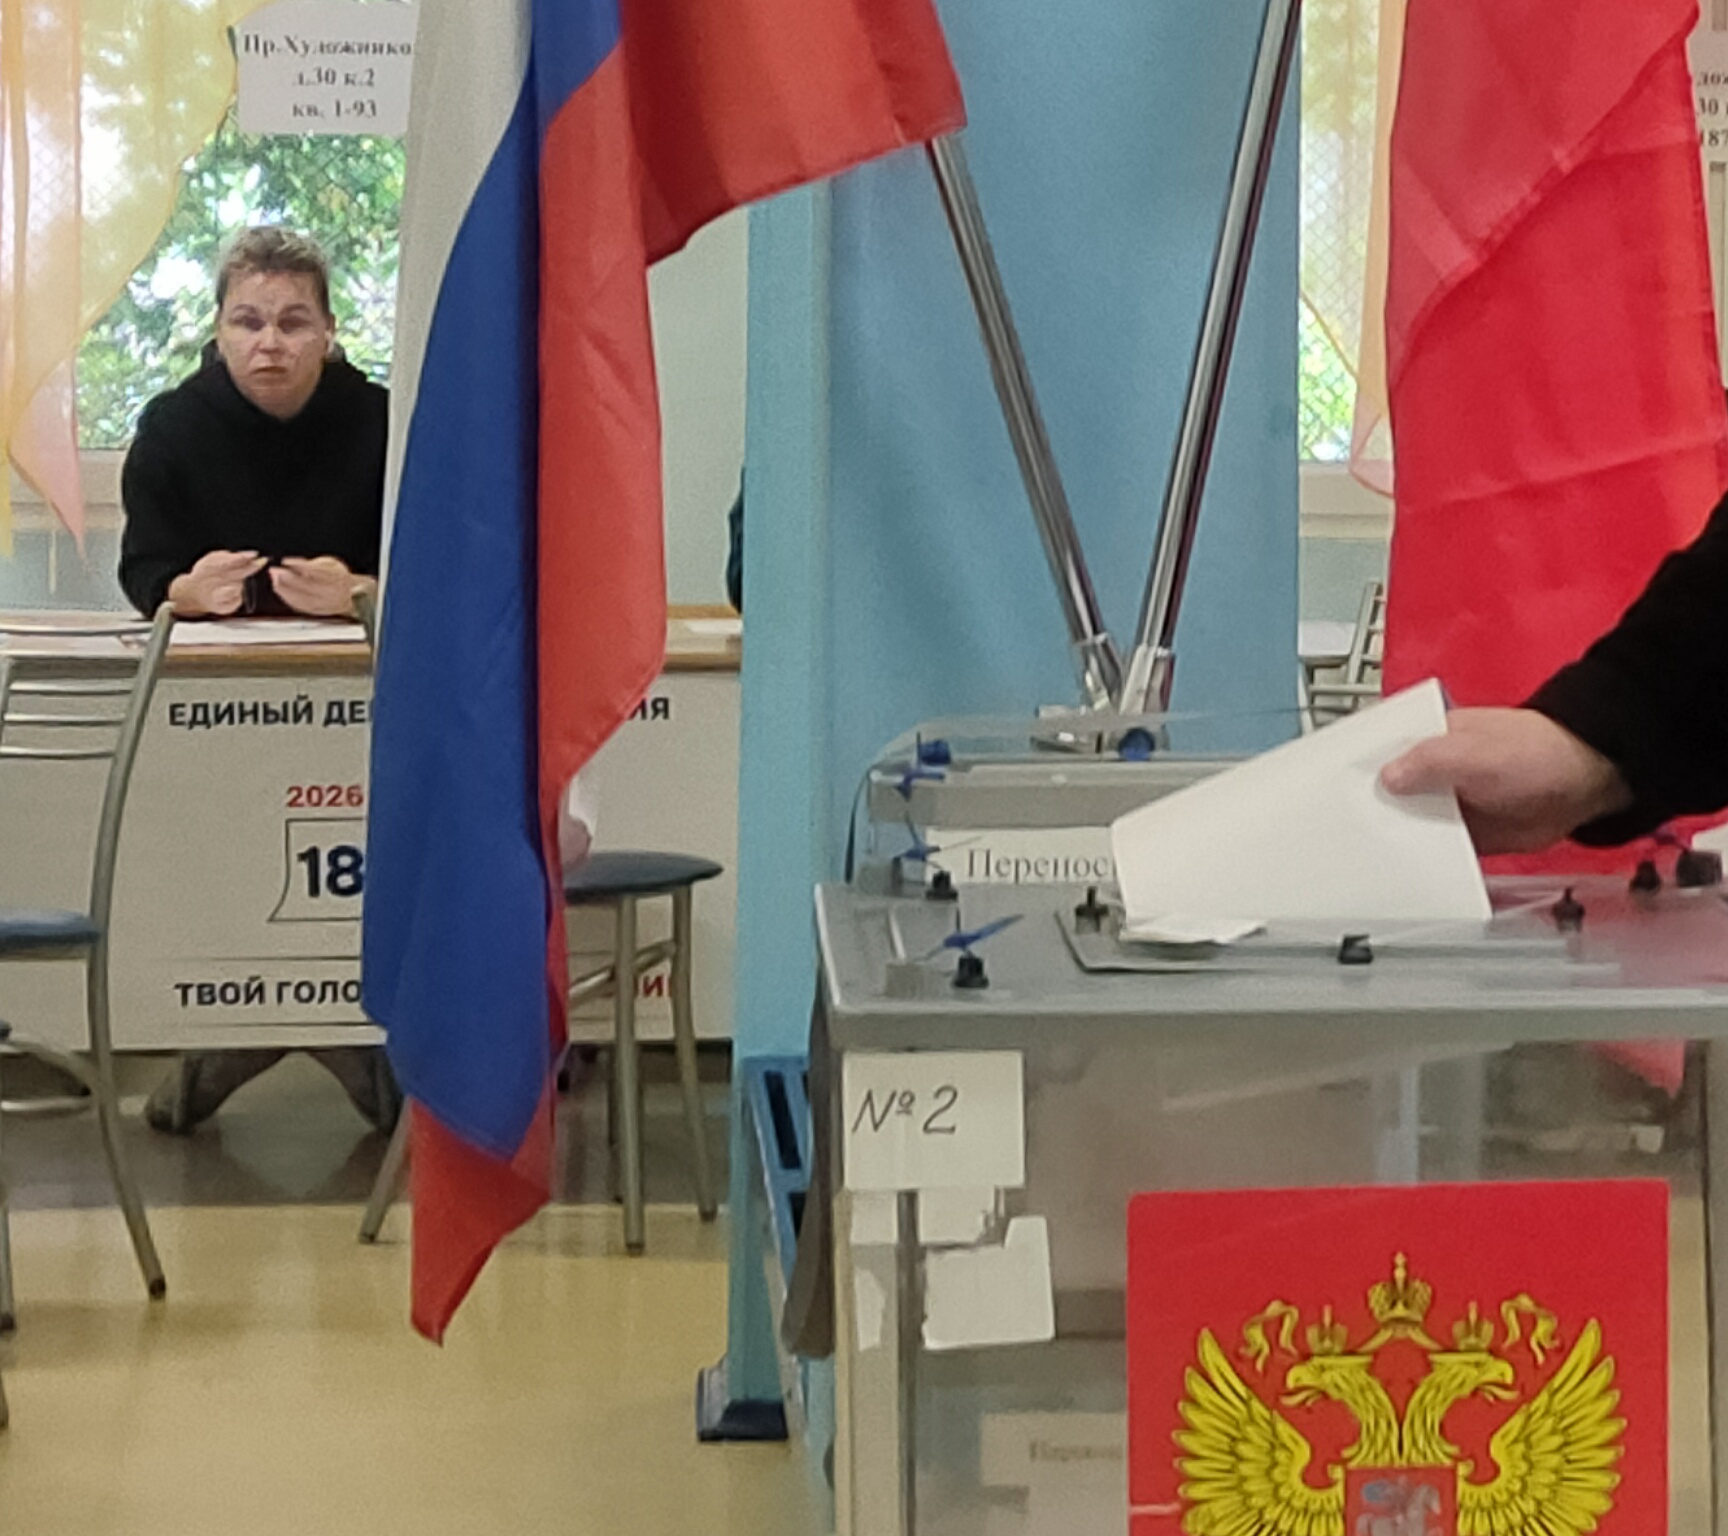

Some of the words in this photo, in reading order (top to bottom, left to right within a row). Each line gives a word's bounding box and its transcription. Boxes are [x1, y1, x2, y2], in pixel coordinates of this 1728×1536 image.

[243, 33, 414, 58] Пр.Художнико
[334, 98, 377, 118] 1-93
[1699, 98, 1719, 115] 30
[168, 694, 314, 730] ЕДИНЫЙ
[322, 700, 372, 727] ДЕ
[285, 784, 364, 808] 2026
[296, 844, 364, 898] 18
[968, 849, 1116, 885] Перенос
[173, 975, 266, 1008] ТВОЙ
[276, 979, 362, 1005] ГОЛО
